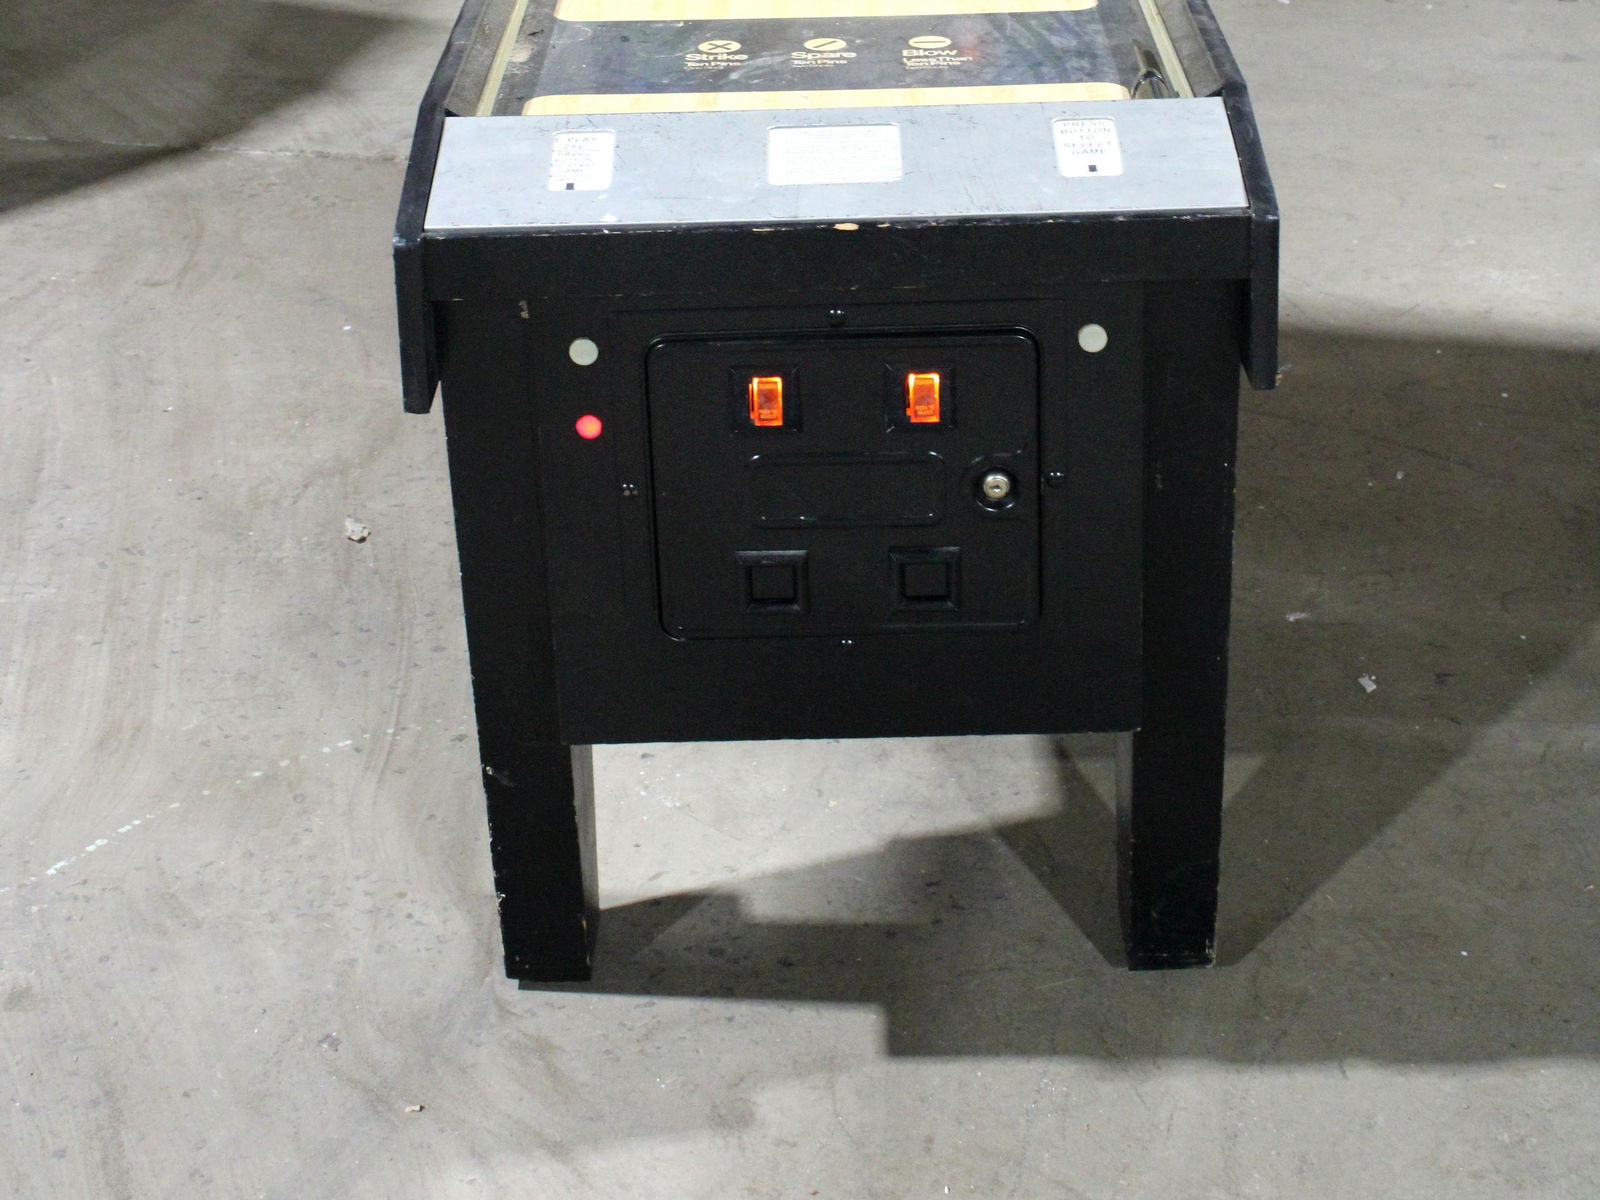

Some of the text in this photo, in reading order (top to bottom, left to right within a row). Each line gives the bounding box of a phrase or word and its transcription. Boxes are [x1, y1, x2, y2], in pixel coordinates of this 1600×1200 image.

[685, 52, 749, 61] Strike
[791, 51, 858, 60] Spare
[902, 49, 958, 57] Blow
